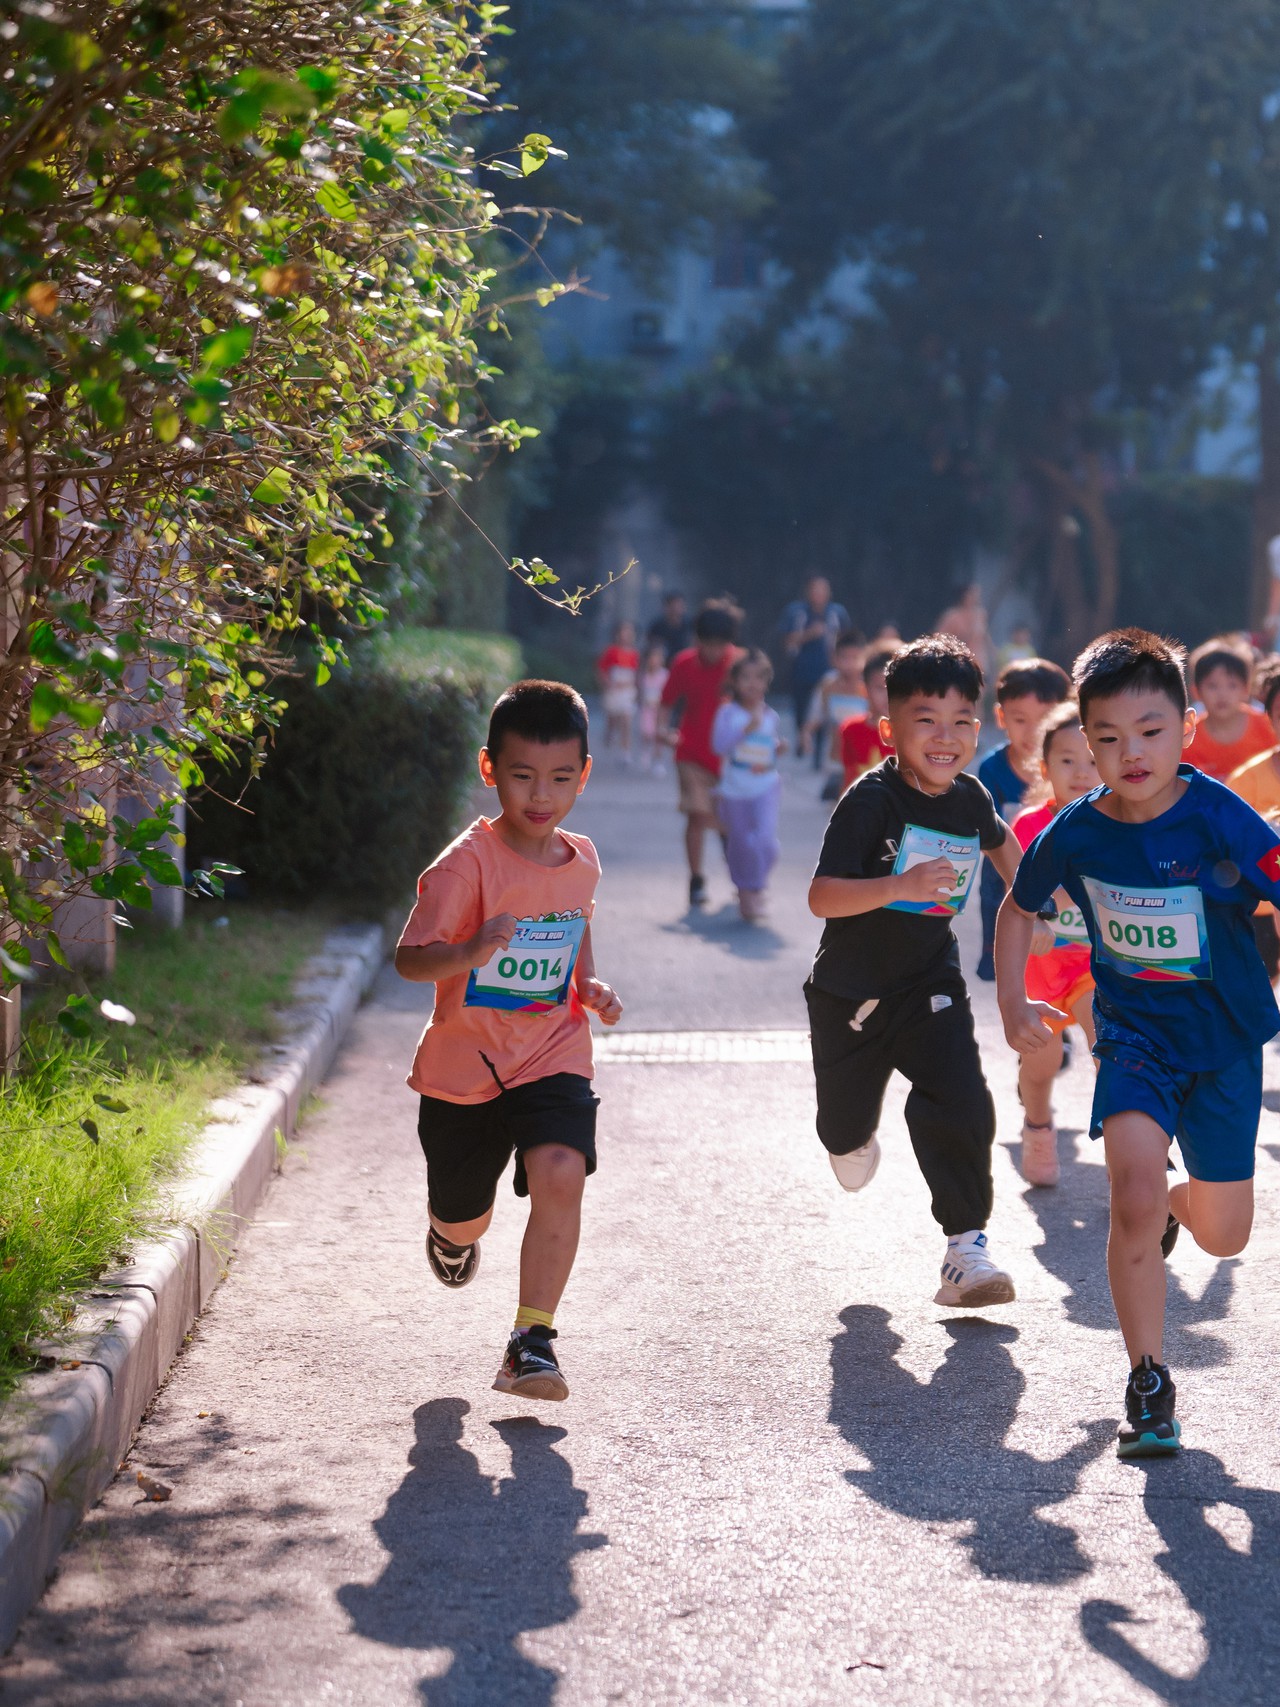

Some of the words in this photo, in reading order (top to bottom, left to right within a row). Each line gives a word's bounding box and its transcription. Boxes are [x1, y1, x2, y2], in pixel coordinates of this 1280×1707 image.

[1125, 897, 1143, 906] FUN
[1144, 898, 1164, 907] RUN
[530, 932, 547, 940] FUN
[547, 931, 564, 940] RUN
[1108, 919, 1178, 949] 0018
[498, 957, 562, 981] 0014
